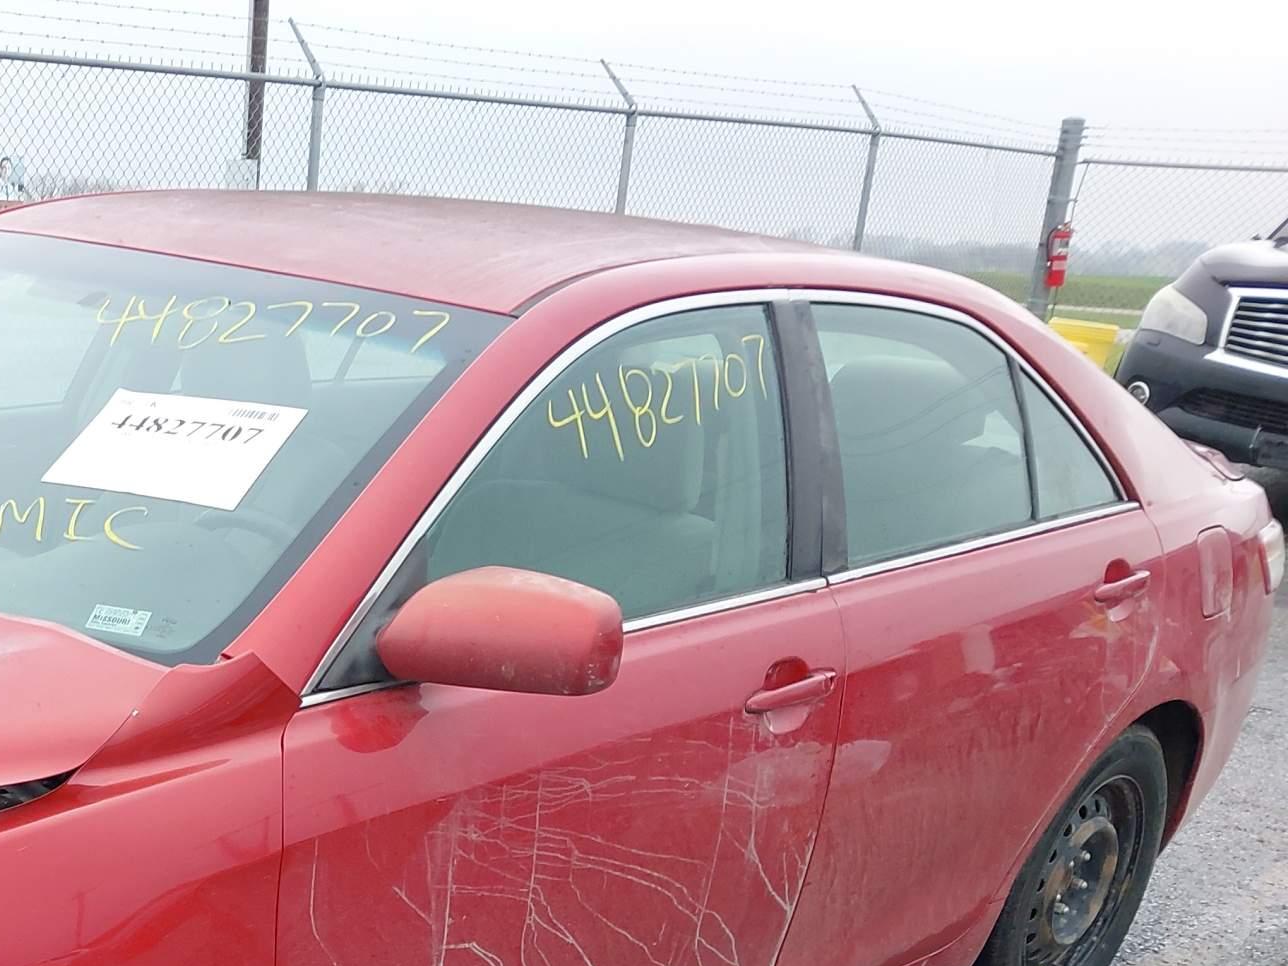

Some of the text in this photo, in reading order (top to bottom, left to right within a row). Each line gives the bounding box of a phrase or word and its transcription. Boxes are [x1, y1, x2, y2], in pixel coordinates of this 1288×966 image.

[96, 295, 451, 353] 44827707
[547, 334, 768, 462] 44827707
[111, 414, 265, 444] 44827707
[93, 613, 131, 626] MISSOURI
